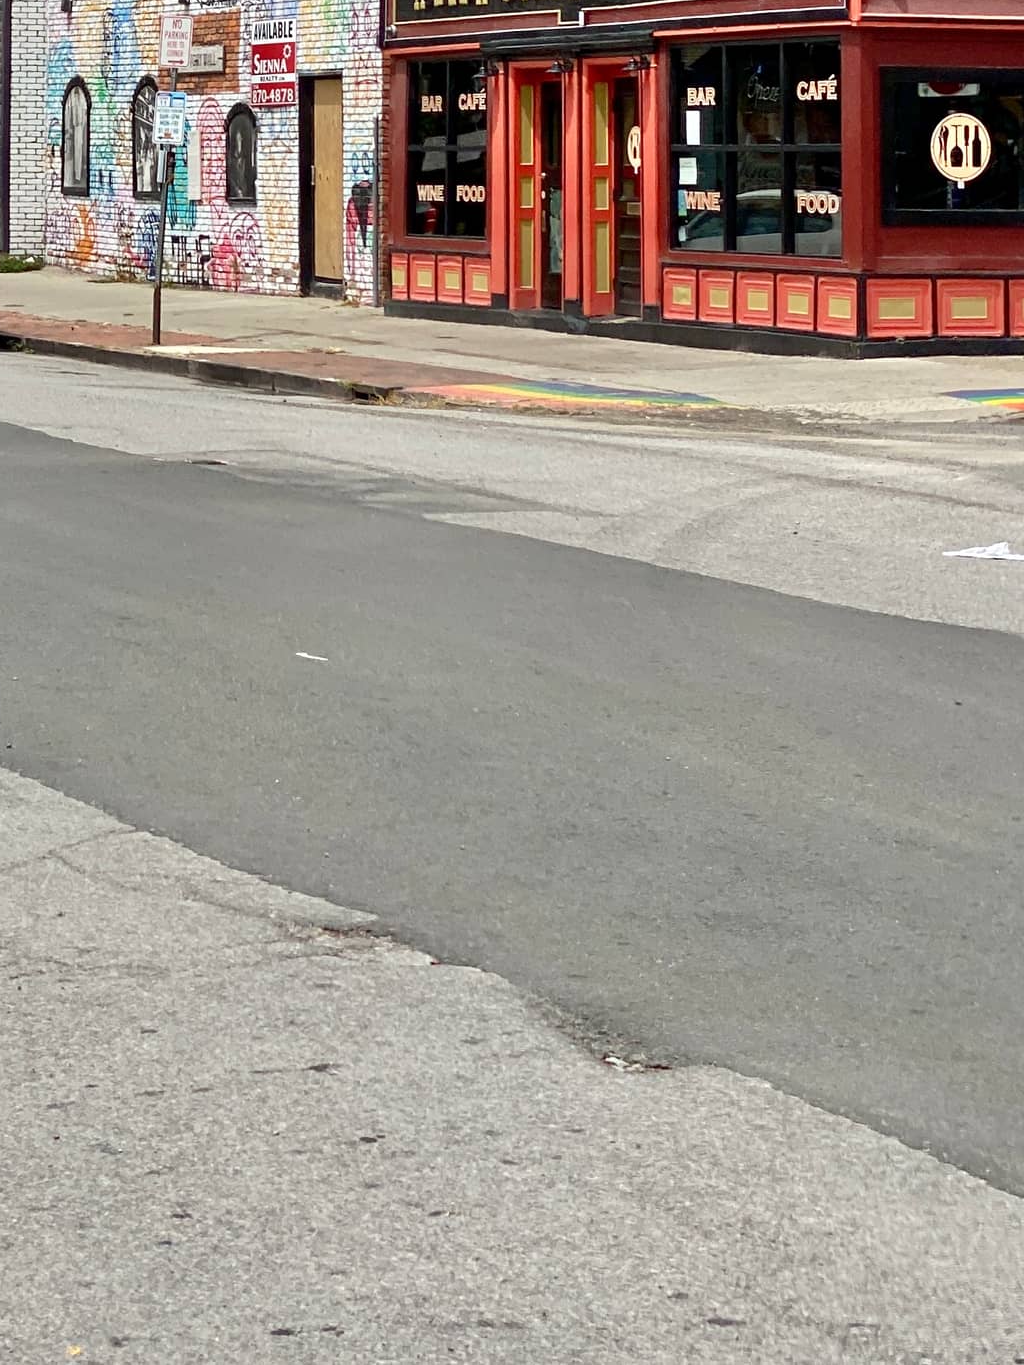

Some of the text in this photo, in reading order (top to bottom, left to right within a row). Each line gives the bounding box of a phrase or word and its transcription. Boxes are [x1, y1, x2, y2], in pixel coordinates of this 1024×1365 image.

[172, 19, 182, 30] NO
[254, 20, 293, 41] AVAILABLE
[165, 32, 188, 40] PARKING
[253, 89, 294, 103] 870-4878
[687, 87, 716, 106] BAR
[796, 74, 838, 101] CAFÉ
[421, 95, 443, 112] BAR
[458, 88, 486, 110] CAFÉ
[417, 185, 444, 202] WINE
[456, 185, 485, 202] FOOD
[685, 191, 721, 211] WINE
[797, 194, 839, 214] FOOD
